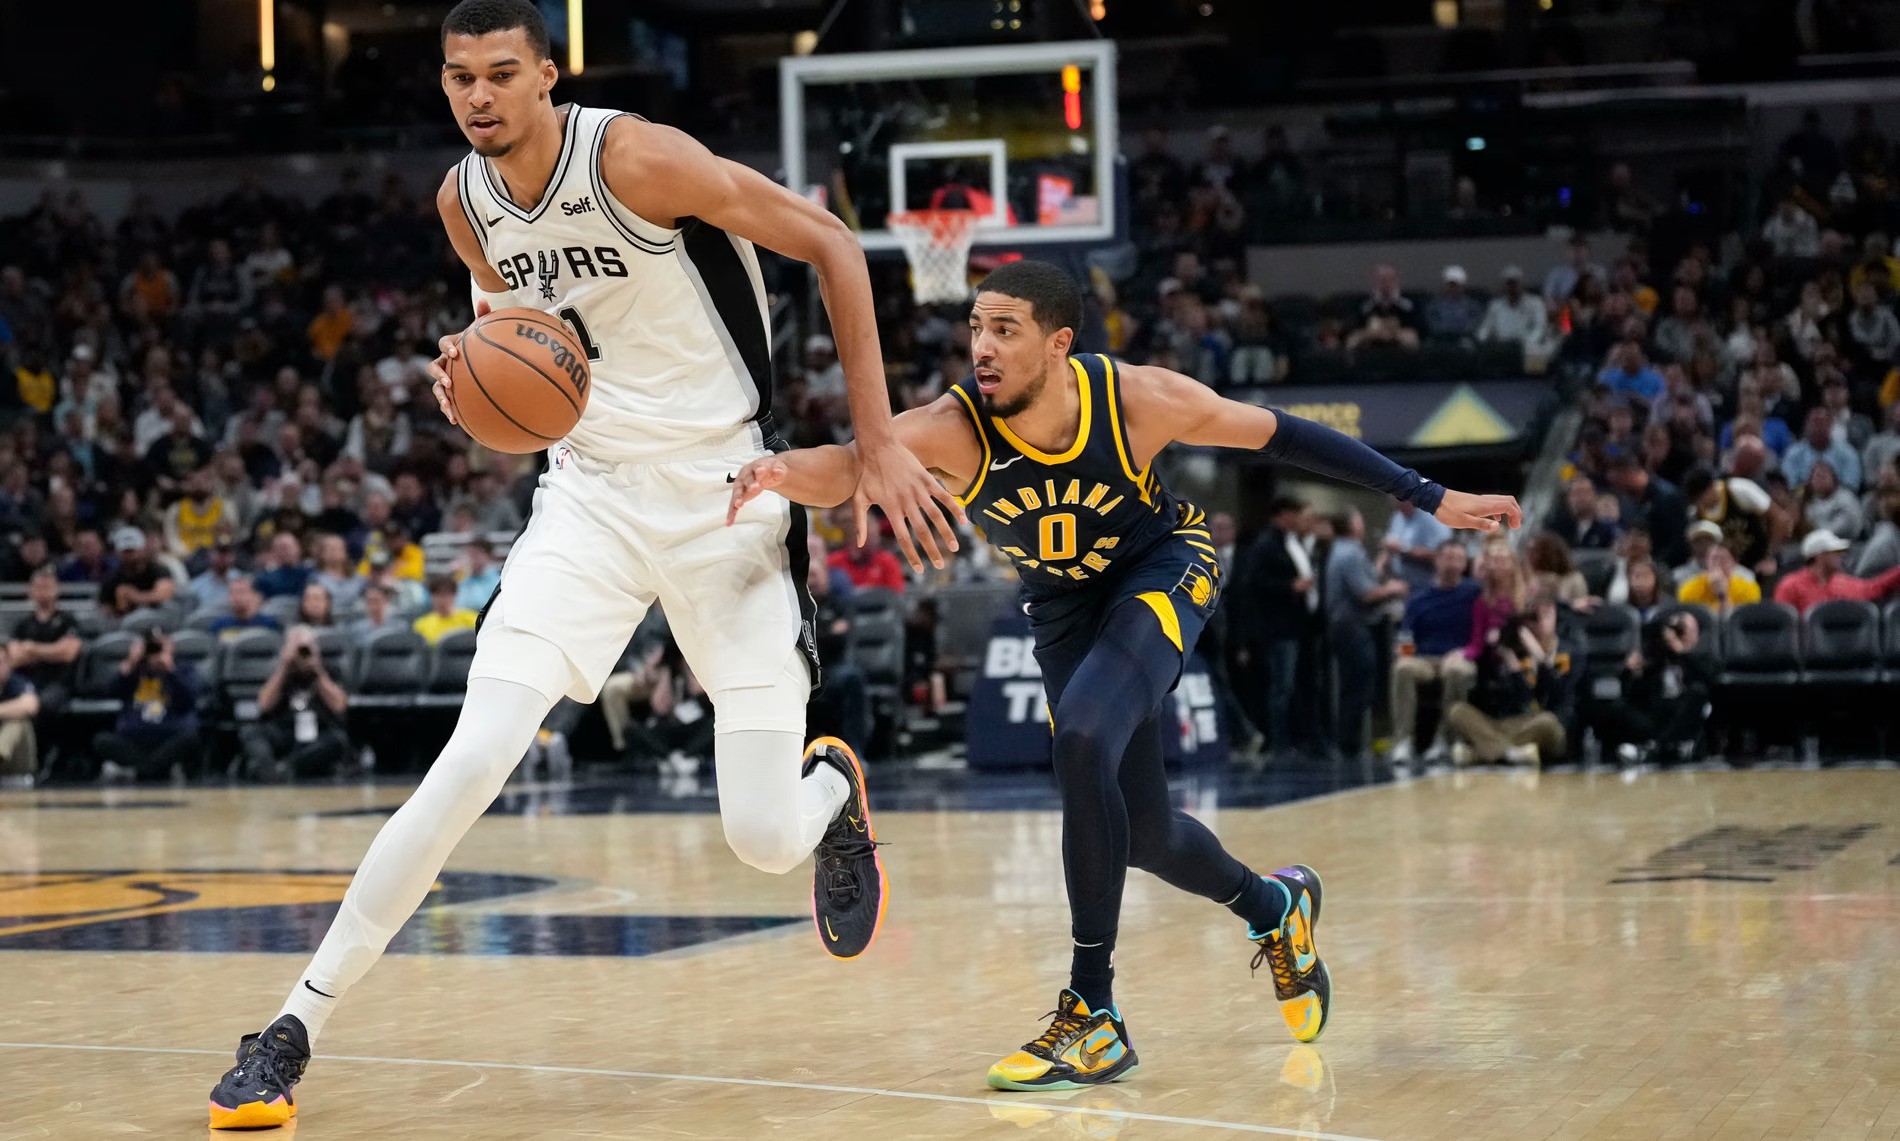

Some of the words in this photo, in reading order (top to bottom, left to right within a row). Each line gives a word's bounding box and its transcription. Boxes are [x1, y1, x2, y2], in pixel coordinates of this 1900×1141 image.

[560, 196, 596, 216] Self.
[497, 246, 629, 303] SPURS
[556, 305, 604, 363] 1
[515, 323, 589, 399] Wilson
[982, 478, 1125, 526] INDIANA
[1001, 536, 1120, 581] PACERS
[1039, 512, 1077, 561] 0
